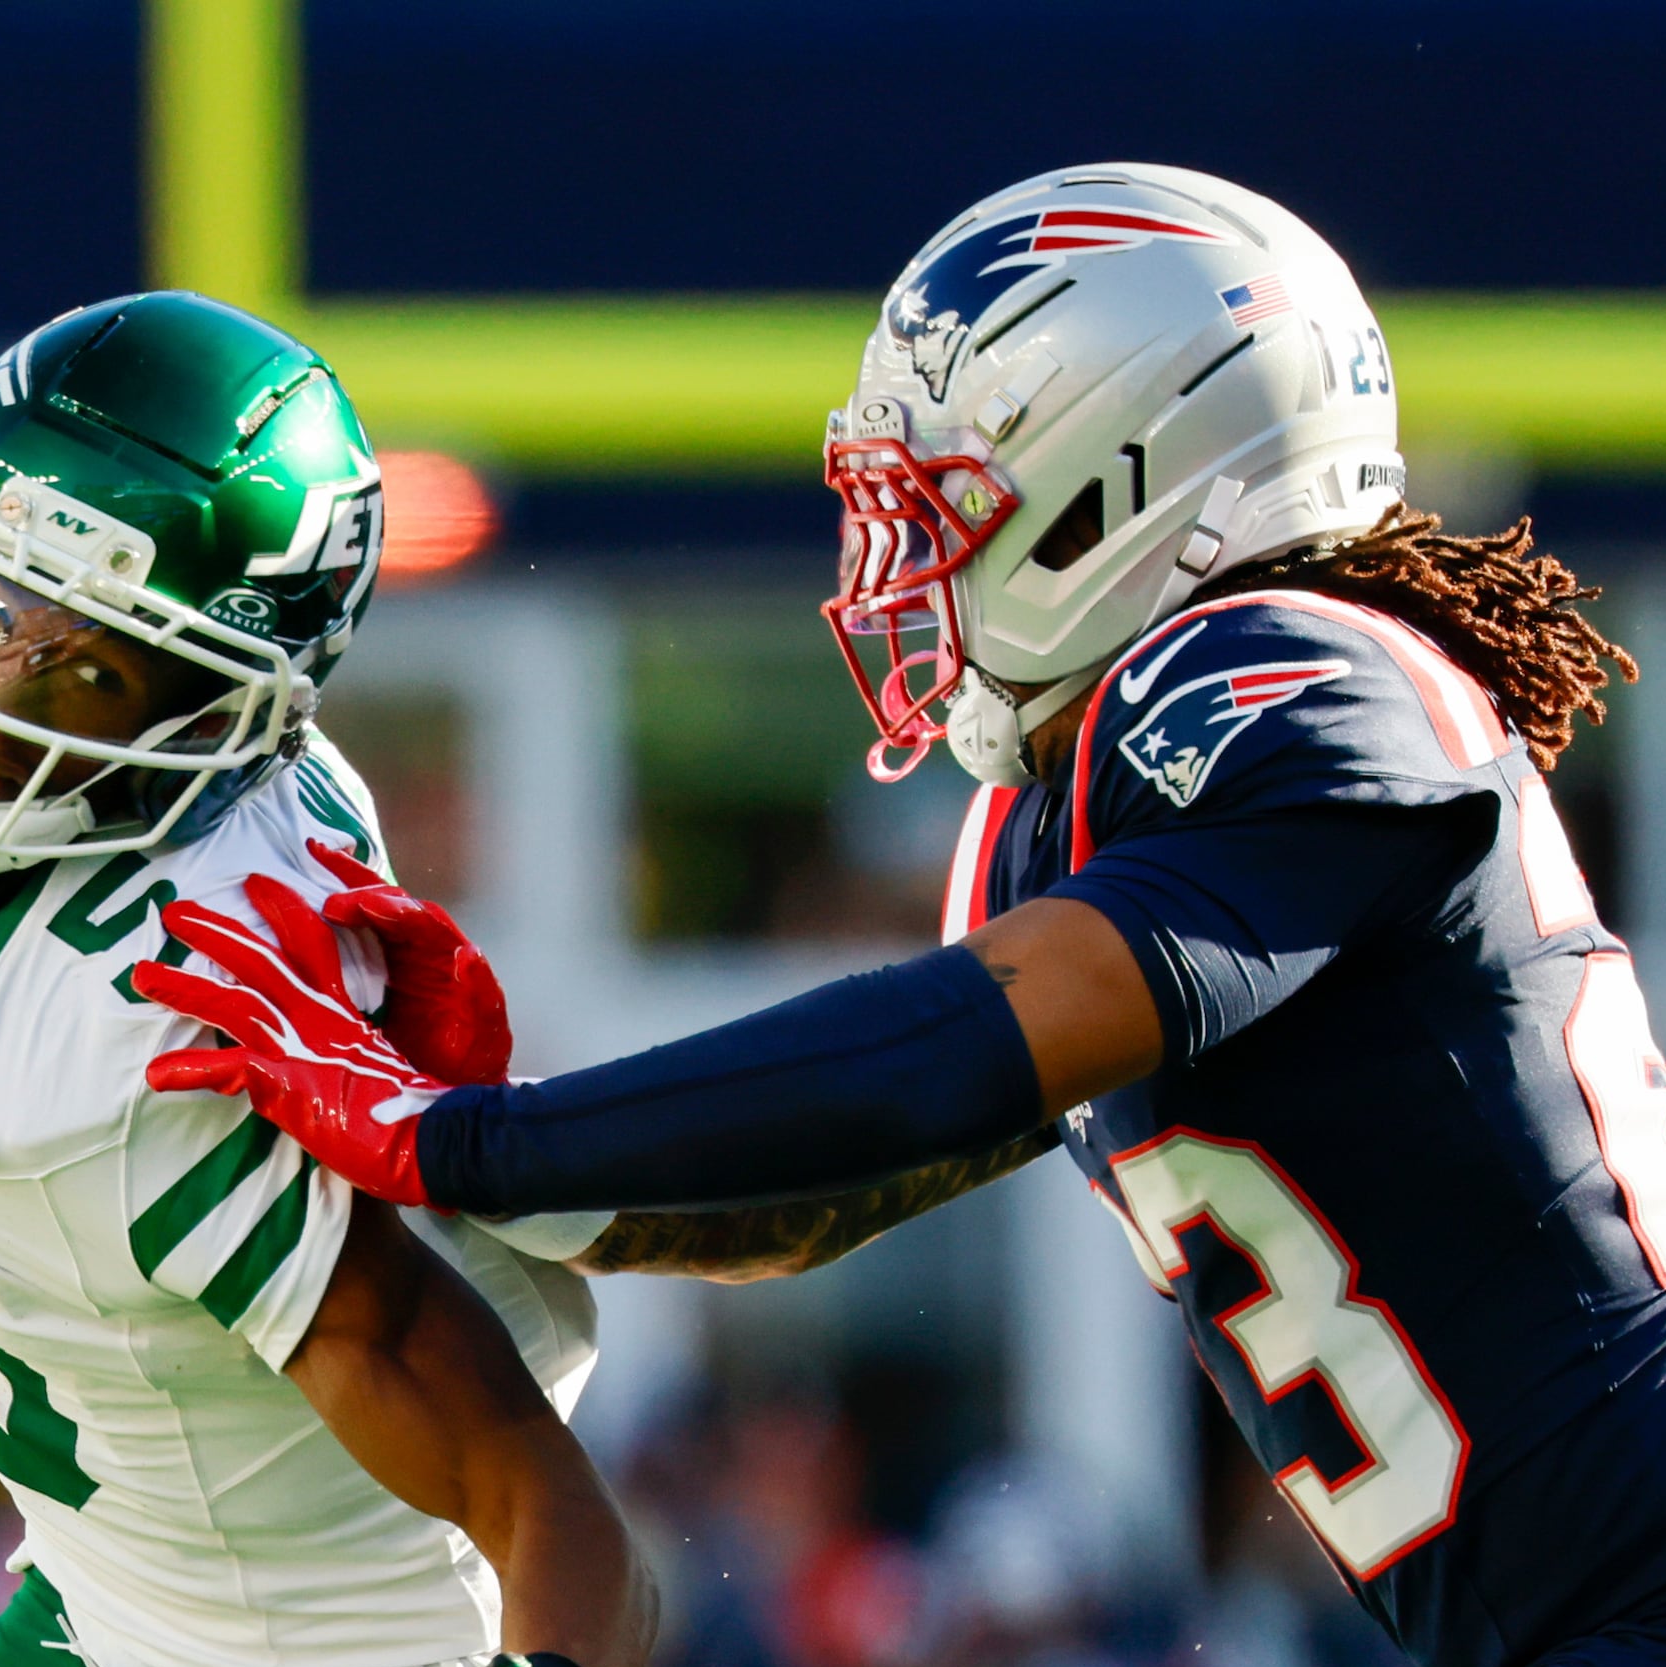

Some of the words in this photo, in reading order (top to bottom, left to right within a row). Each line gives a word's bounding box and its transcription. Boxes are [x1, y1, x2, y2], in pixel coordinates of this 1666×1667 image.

[1349, 327, 1390, 395] 23
[1363, 463, 1406, 496] PATRI
[210, 606, 272, 633] OAKLEY
[1089, 1123, 1471, 1581] 3
